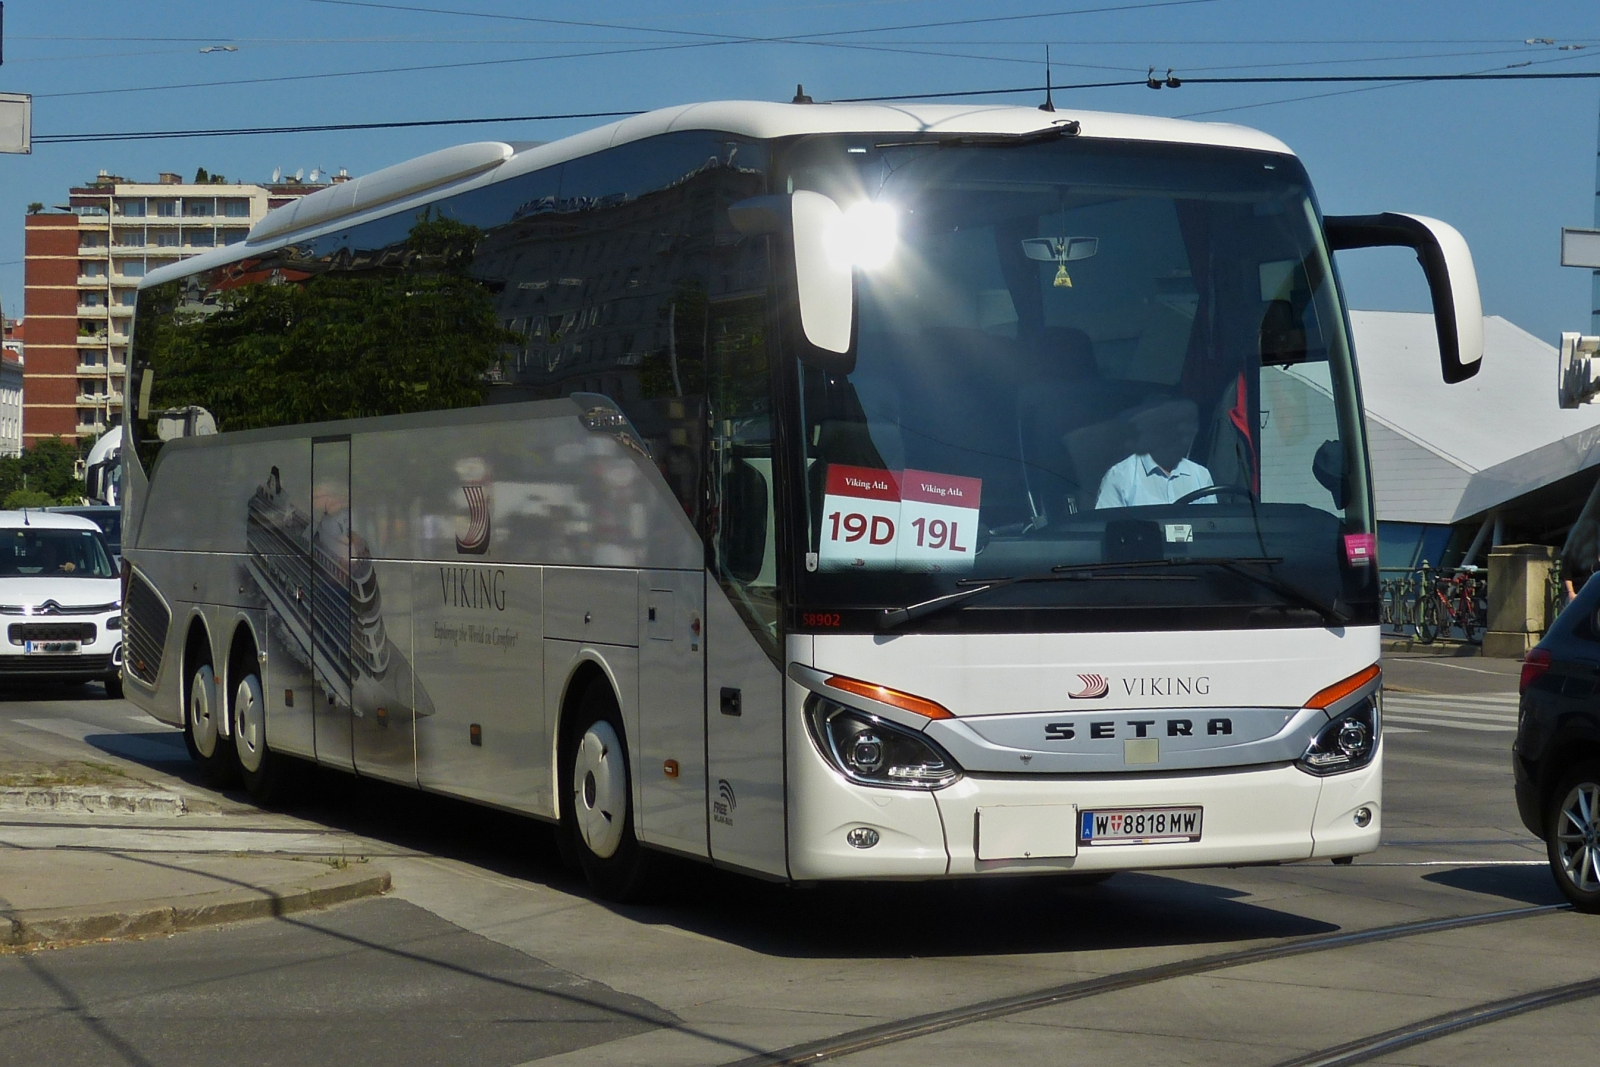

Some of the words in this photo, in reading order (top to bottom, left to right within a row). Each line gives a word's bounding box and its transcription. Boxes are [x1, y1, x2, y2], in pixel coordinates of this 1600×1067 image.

[845, 477, 871, 491] Viking
[872, 480, 888, 490] Atla
[920, 483, 946, 496] Viking
[947, 487, 963, 497] Atla
[828, 511, 895, 545] 19D
[911, 517, 967, 552] 19L
[440, 567, 505, 611] VIKING
[1122, 677, 1210, 696] VIKING
[1044, 718, 1233, 740] SETRA
[1096, 816, 1109, 835] W
[1123, 814, 1166, 834] 8818
[1170, 813, 1197, 833] MW
